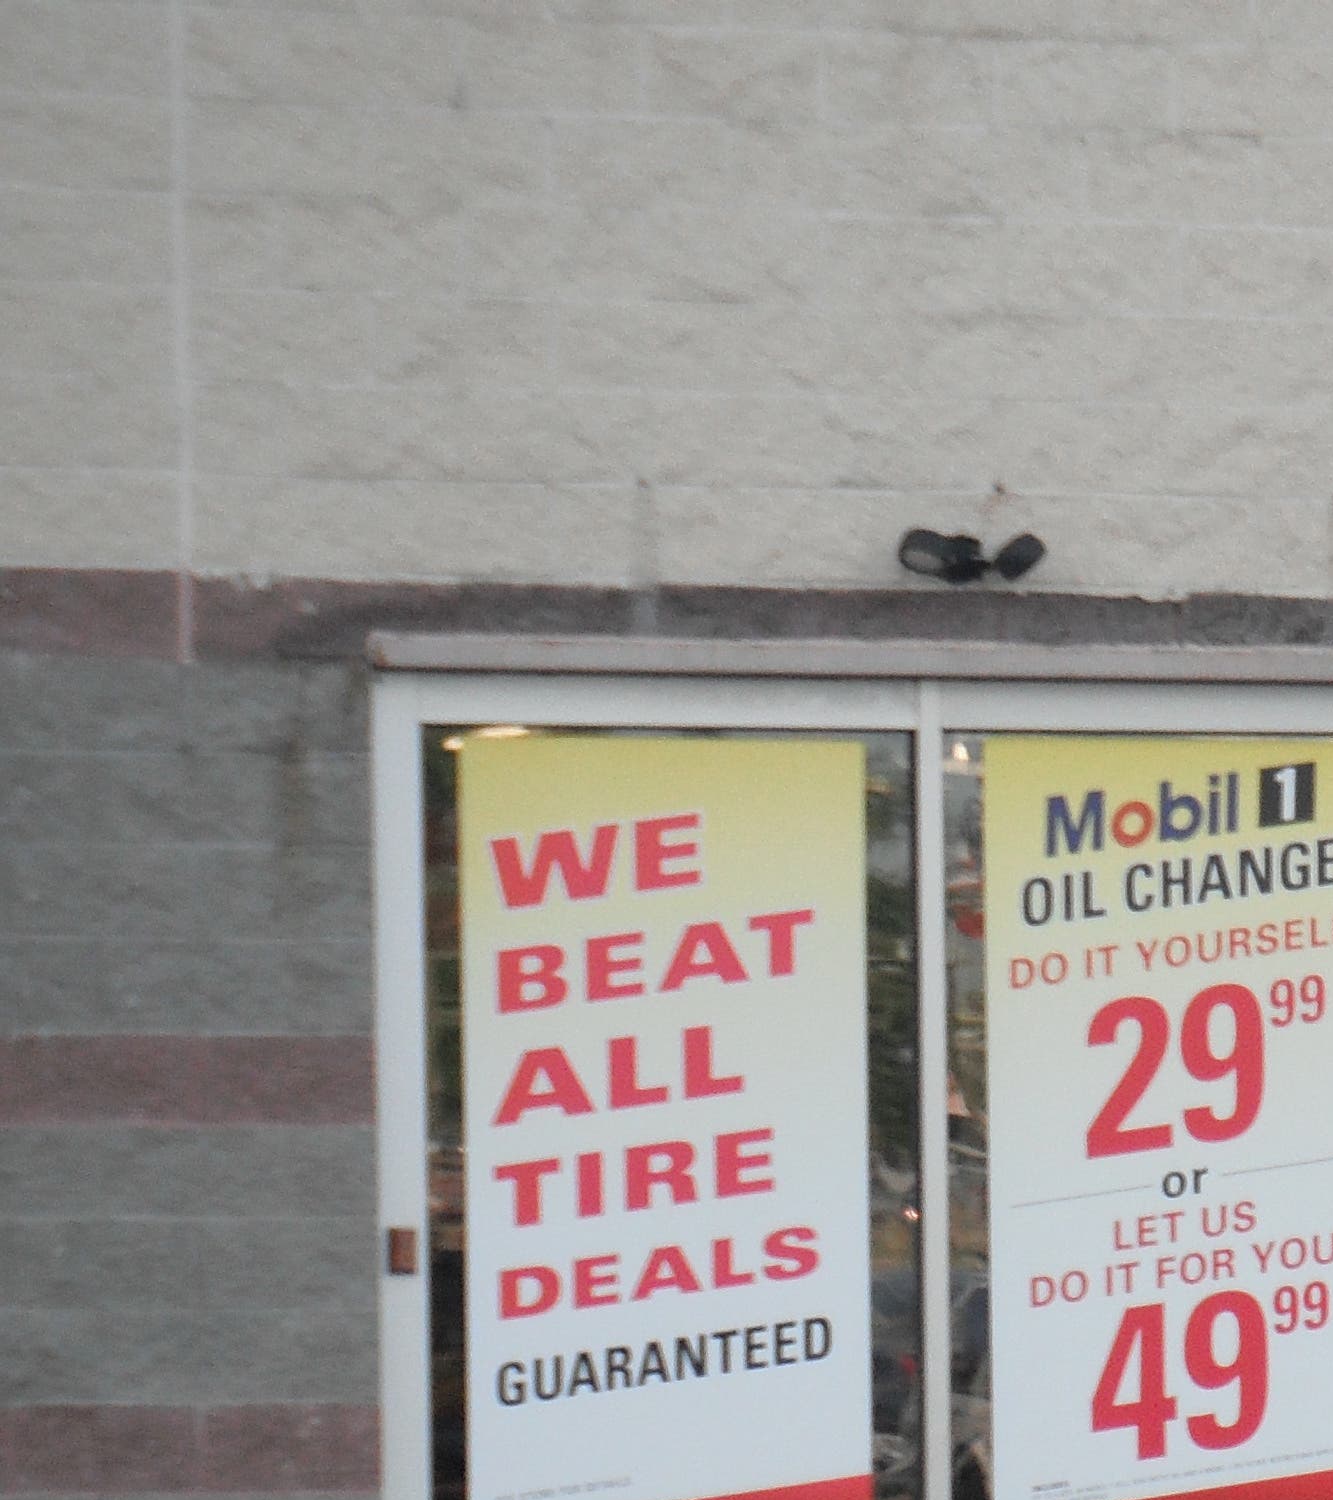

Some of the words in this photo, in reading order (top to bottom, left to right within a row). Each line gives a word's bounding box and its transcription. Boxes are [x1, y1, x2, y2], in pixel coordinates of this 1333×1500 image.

[1045, 772, 1240, 857] Mobil
[1266, 764, 1309, 827] 1
[488, 814, 702, 910] WE
[1022, 870, 1106, 927] OIL
[495, 910, 815, 1015] BEAT
[1009, 951, 1069, 990] DO
[1085, 943, 1120, 979] IT
[492, 1025, 745, 1127] ALL
[1085, 983, 1266, 1161] 29
[1269, 974, 1328, 1029] 99
[494, 1128, 776, 1228] TIRE
[1160, 1165, 1209, 1201] or
[1113, 1211, 1186, 1252] LET
[1201, 1200, 1258, 1238] US
[498, 1226, 820, 1320] DEALS
[1029, 1270, 1089, 1309] DO
[1104, 1262, 1138, 1298] IT
[1156, 1247, 1235, 1290] FOR
[496, 1315, 834, 1408] GUARANTEED
[1090, 1289, 1270, 1463] 49
[1272, 1279, 1331, 1336] 99
